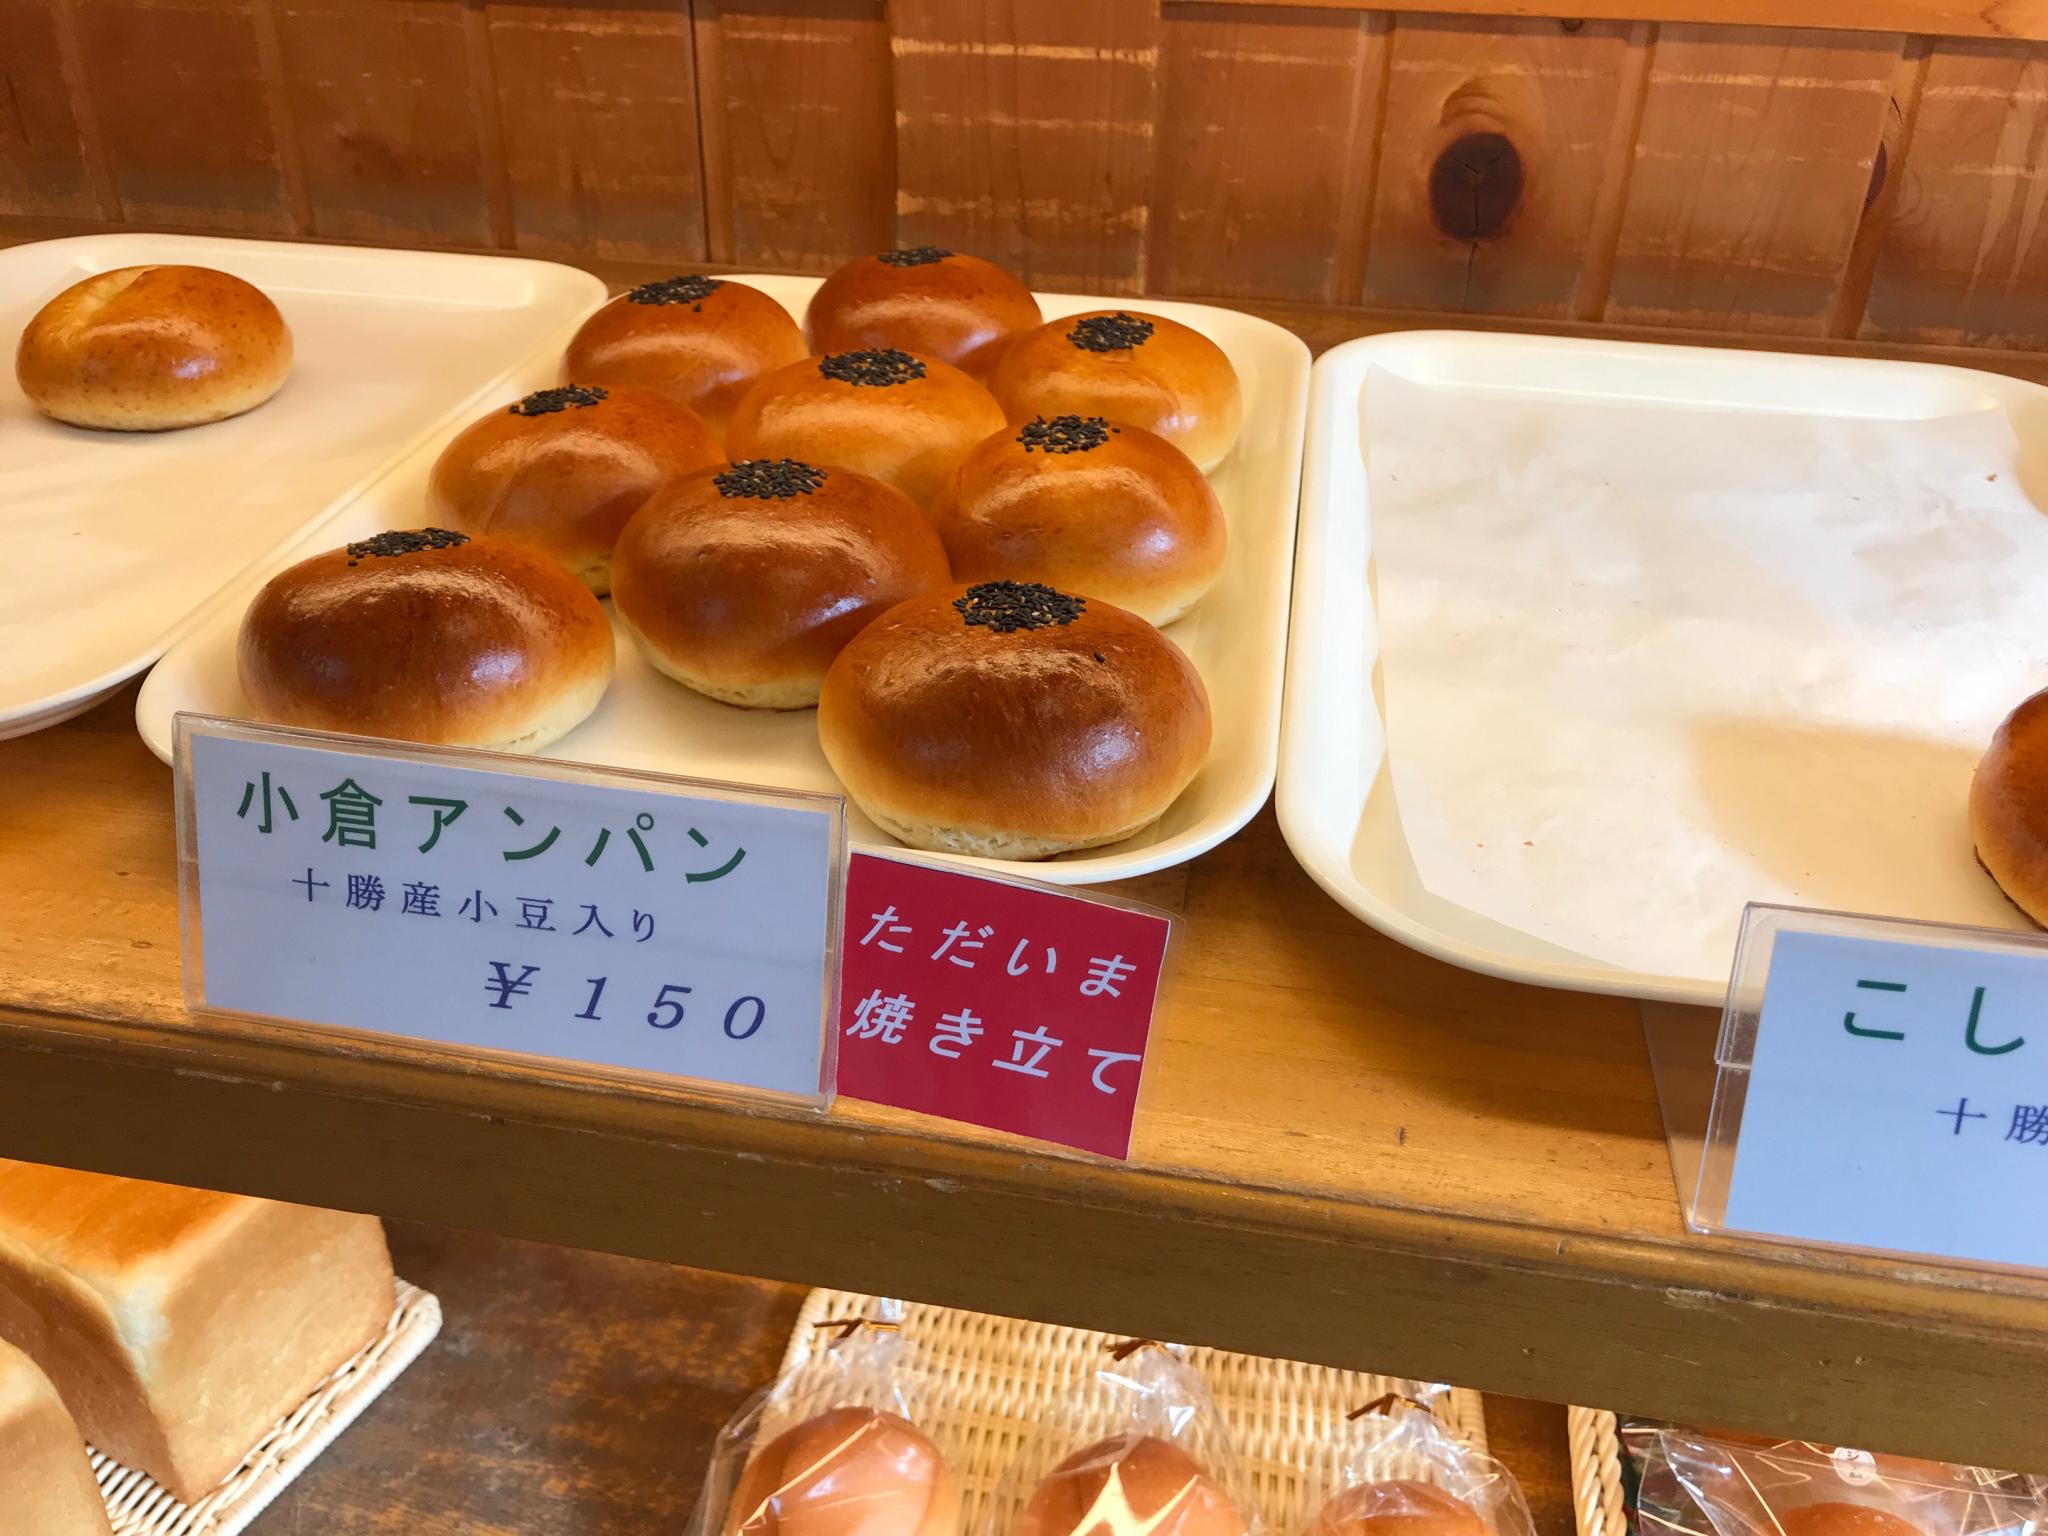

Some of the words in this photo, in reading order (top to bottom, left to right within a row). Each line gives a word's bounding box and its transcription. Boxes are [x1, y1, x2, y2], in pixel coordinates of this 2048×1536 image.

[236, 770, 747, 884] 小倉アンパン
[291, 867, 656, 943] 十勝産小豆入り
[859, 904, 1137, 999] ただいま
[845, 988, 1142, 1095] 焼き立て
[1844, 980, 2025, 1055] こし
